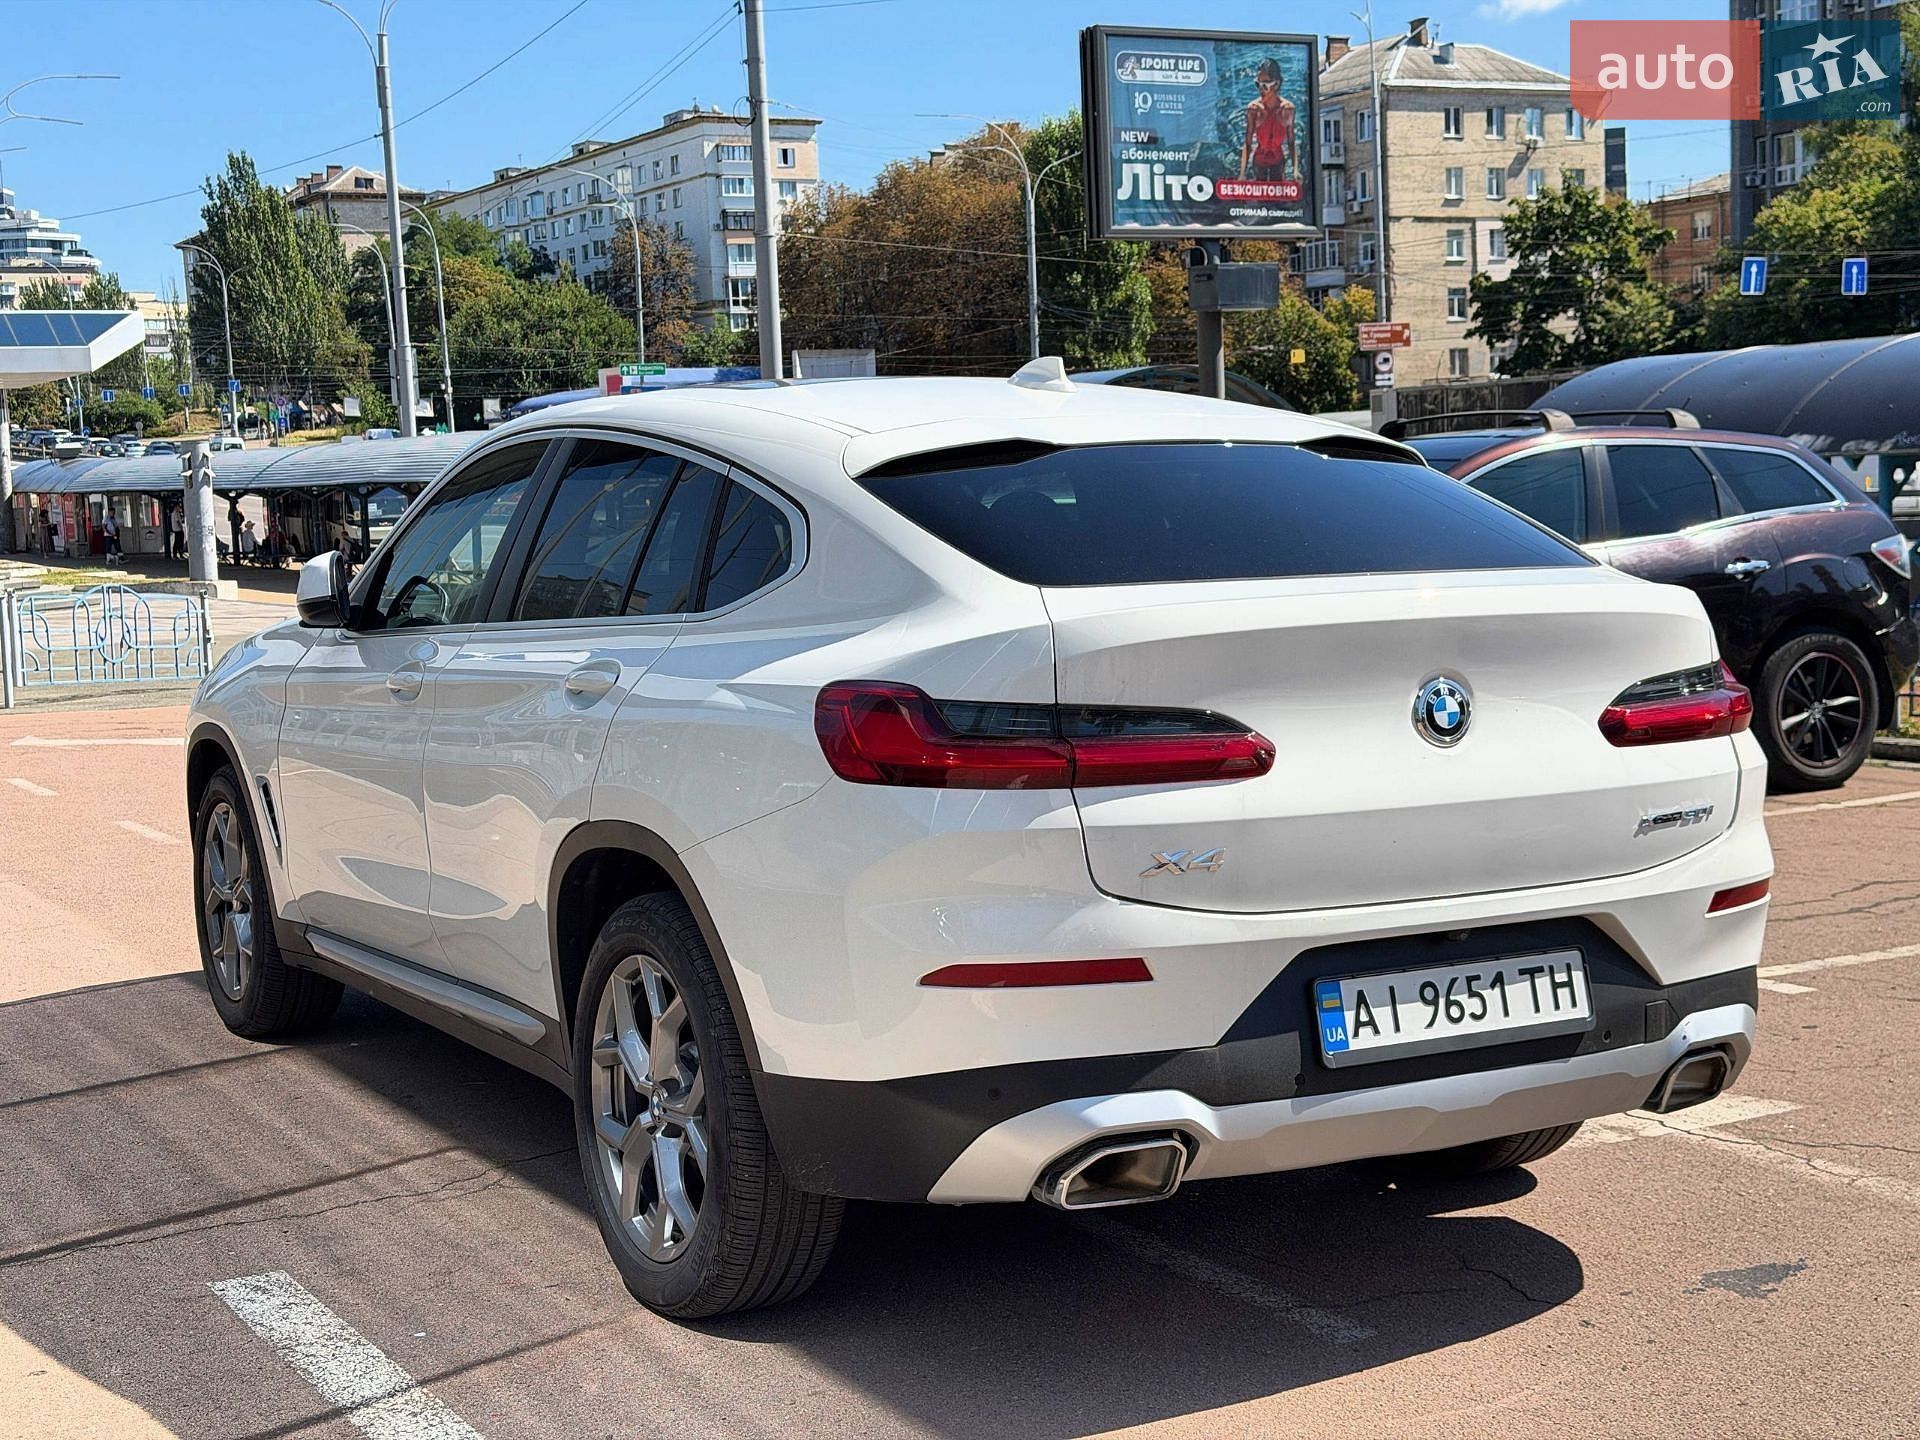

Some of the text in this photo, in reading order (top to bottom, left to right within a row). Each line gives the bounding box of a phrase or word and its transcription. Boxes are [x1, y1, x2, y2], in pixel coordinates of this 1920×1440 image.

[1141, 57, 1200, 71] SPORT LIFE
[1156, 102, 1183, 110] CENTER
[1120, 130, 1149, 143] NEW
[1121, 147, 1189, 161] абонемент
[1117, 163, 1214, 202] Літо
[1220, 183, 1298, 197] БЕЗКОШТОВНО
[1229, 207, 1267, 217] ОТРИМАЙ
[1137, 847, 1226, 877] X4
[1352, 962, 1578, 1040] AI 9651 TH
[1326, 1026, 1346, 1043] UA
